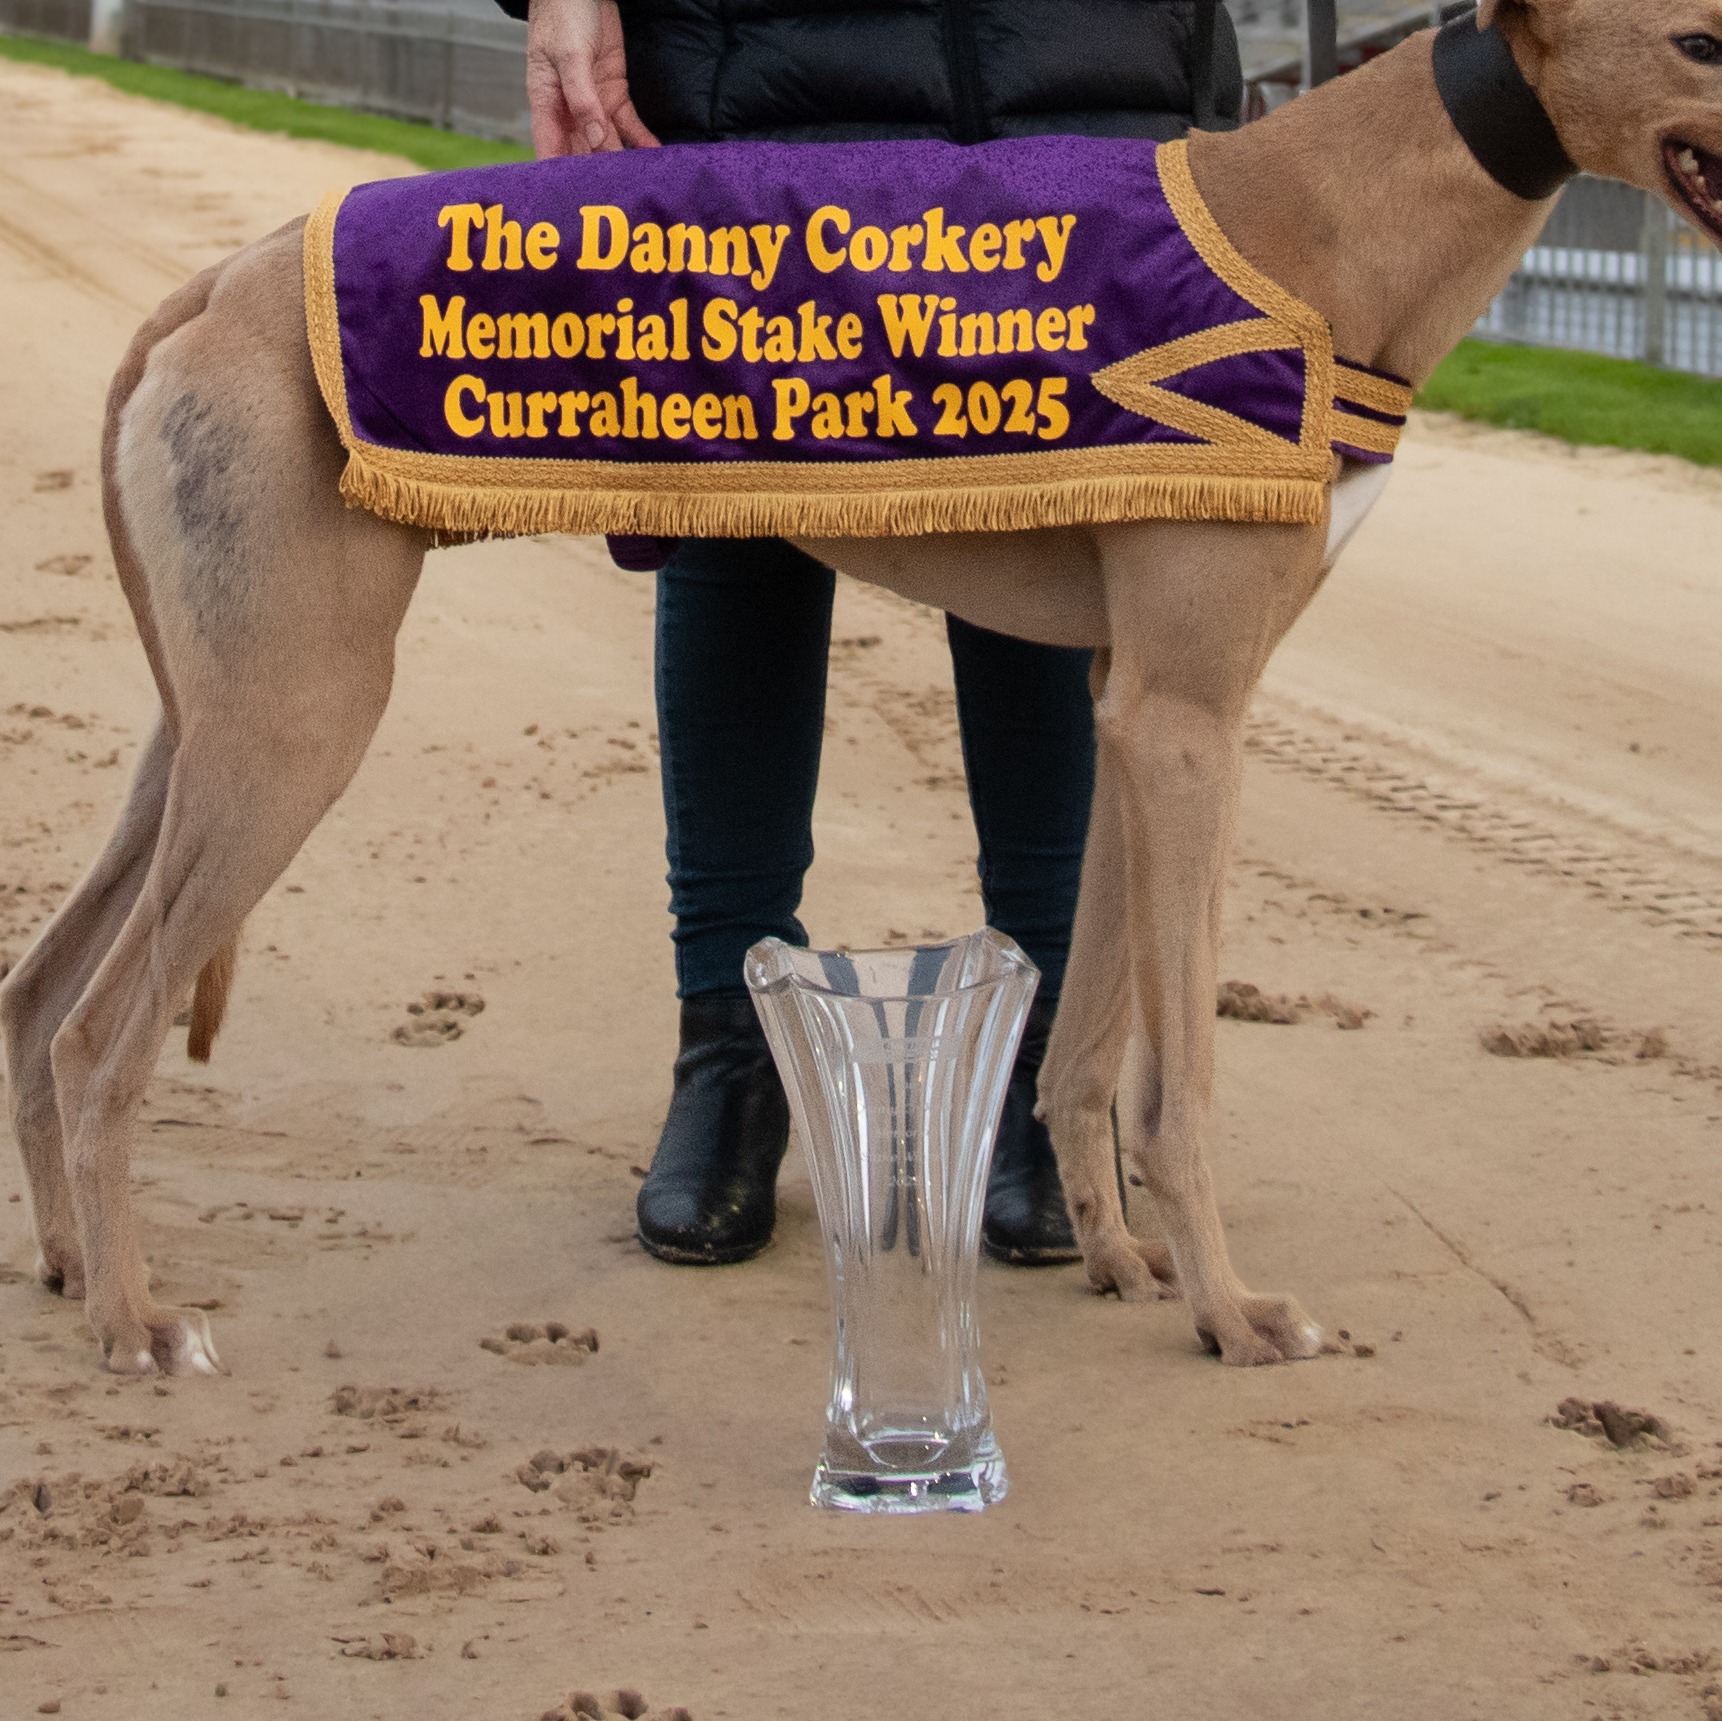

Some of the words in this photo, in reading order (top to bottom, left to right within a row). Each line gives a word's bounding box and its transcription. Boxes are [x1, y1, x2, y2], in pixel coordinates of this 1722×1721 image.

[439, 204, 559, 271] The
[577, 206, 790, 290] Danny
[806, 206, 1077, 282] Corkery
[420, 295, 690, 361] Memorial
[701, 298, 863, 364] Stake
[877, 295, 1095, 358] Winner
[444, 375, 758, 439] Curraheen
[772, 375, 918, 441] Park
[932, 377, 1070, 441] 2025
